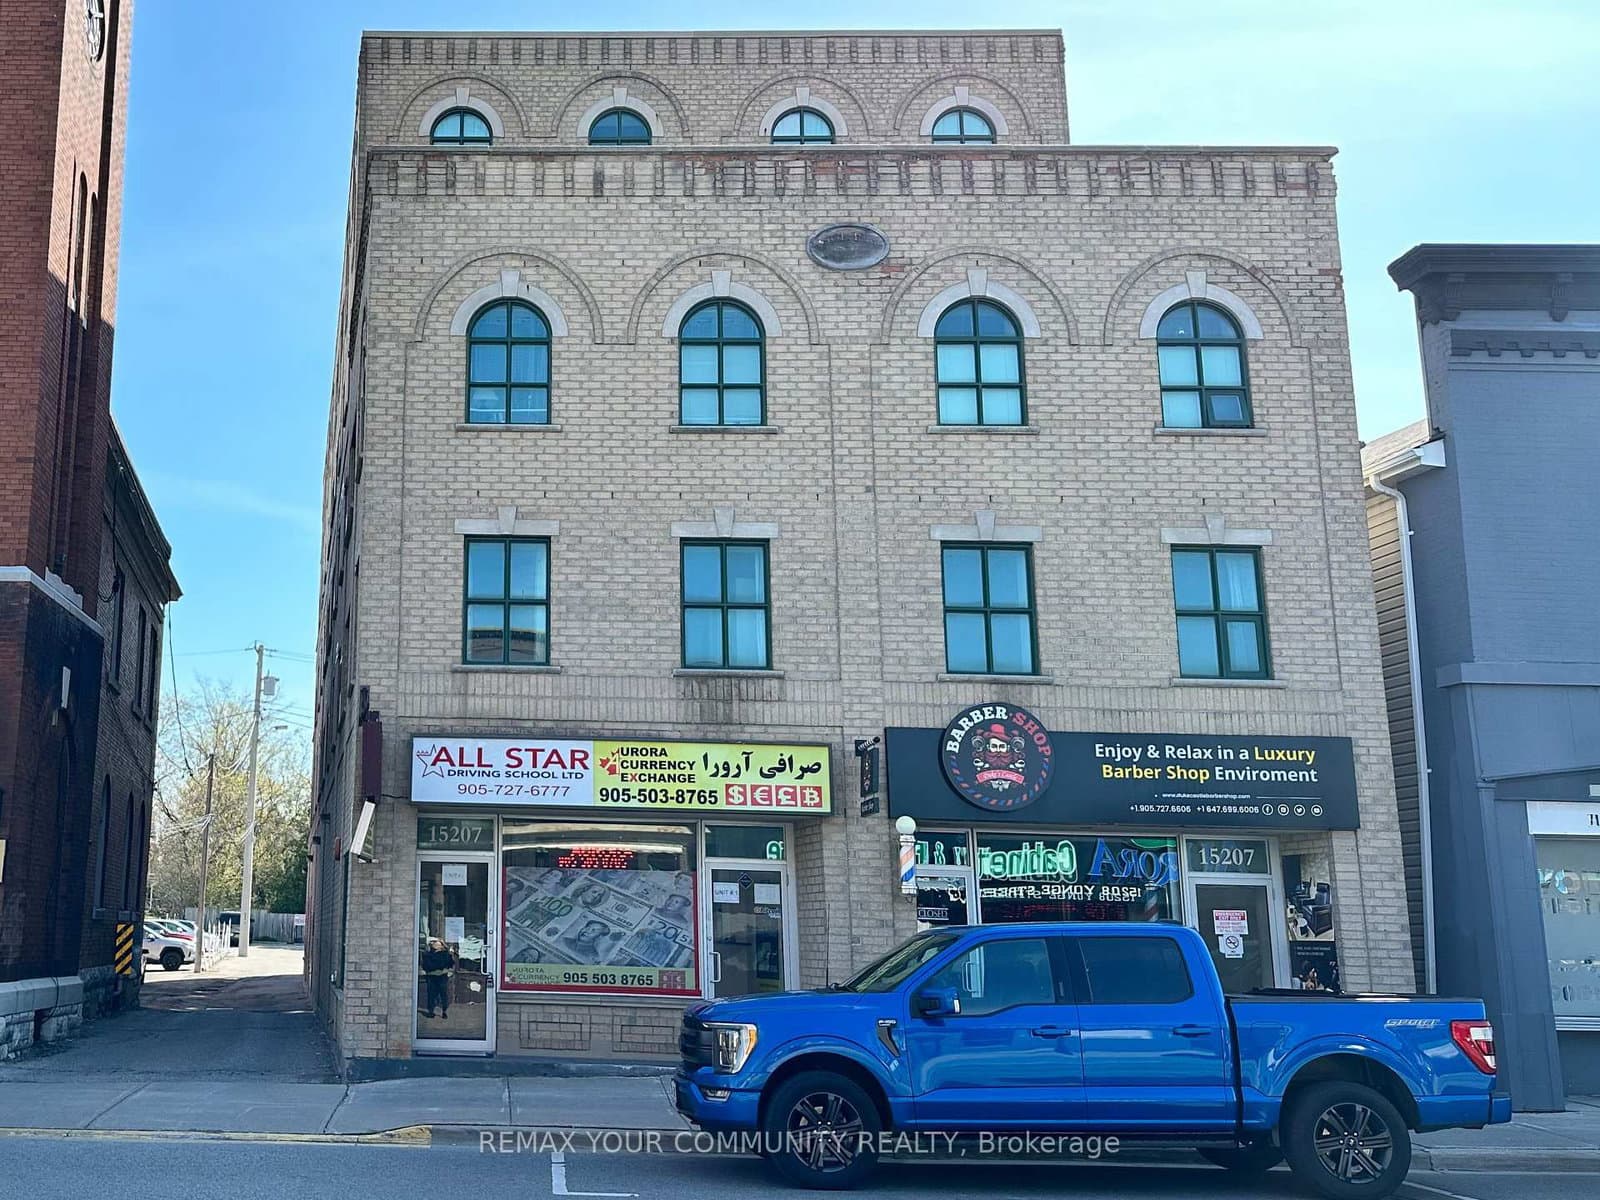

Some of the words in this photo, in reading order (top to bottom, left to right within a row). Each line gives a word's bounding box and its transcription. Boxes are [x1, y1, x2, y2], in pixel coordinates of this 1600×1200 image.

[946, 706, 1008, 753] BARBER
[1012, 712, 1051, 756] SHOP
[430, 746, 493, 768] ALL
[505, 748, 590, 770] STAR
[1095, 743, 1142, 761] Enjoy
[1147, 745, 1160, 759] &
[1165, 745, 1213, 760] Relax
[1217, 745, 1234, 760] in
[1238, 749, 1249, 760] a
[1254, 747, 1316, 765] Luxury
[621, 760, 696, 770] CURRENCY
[703, 752, 753, 778] آرورا
[759, 752, 822, 780] صرافی
[1102, 764, 1162, 779] Barber
[1166, 765, 1210, 783] Shop
[1214, 767, 1318, 782] Enviroment
[447, 769, 500, 778] DRIVING
[505, 770, 558, 779] SCHOOL
[562, 771, 584, 780] LTD
[621, 773, 696, 783] EXCHANGE
[457, 783, 570, 797] 905-727-6777
[599, 787, 719, 804] 905-503-8765
[428, 826, 482, 844] 15207
[1199, 849, 1254, 866] 15207
[563, 972, 588, 984] 905
[592, 973, 617, 986] 503
[621, 975, 653, 986] 8765
